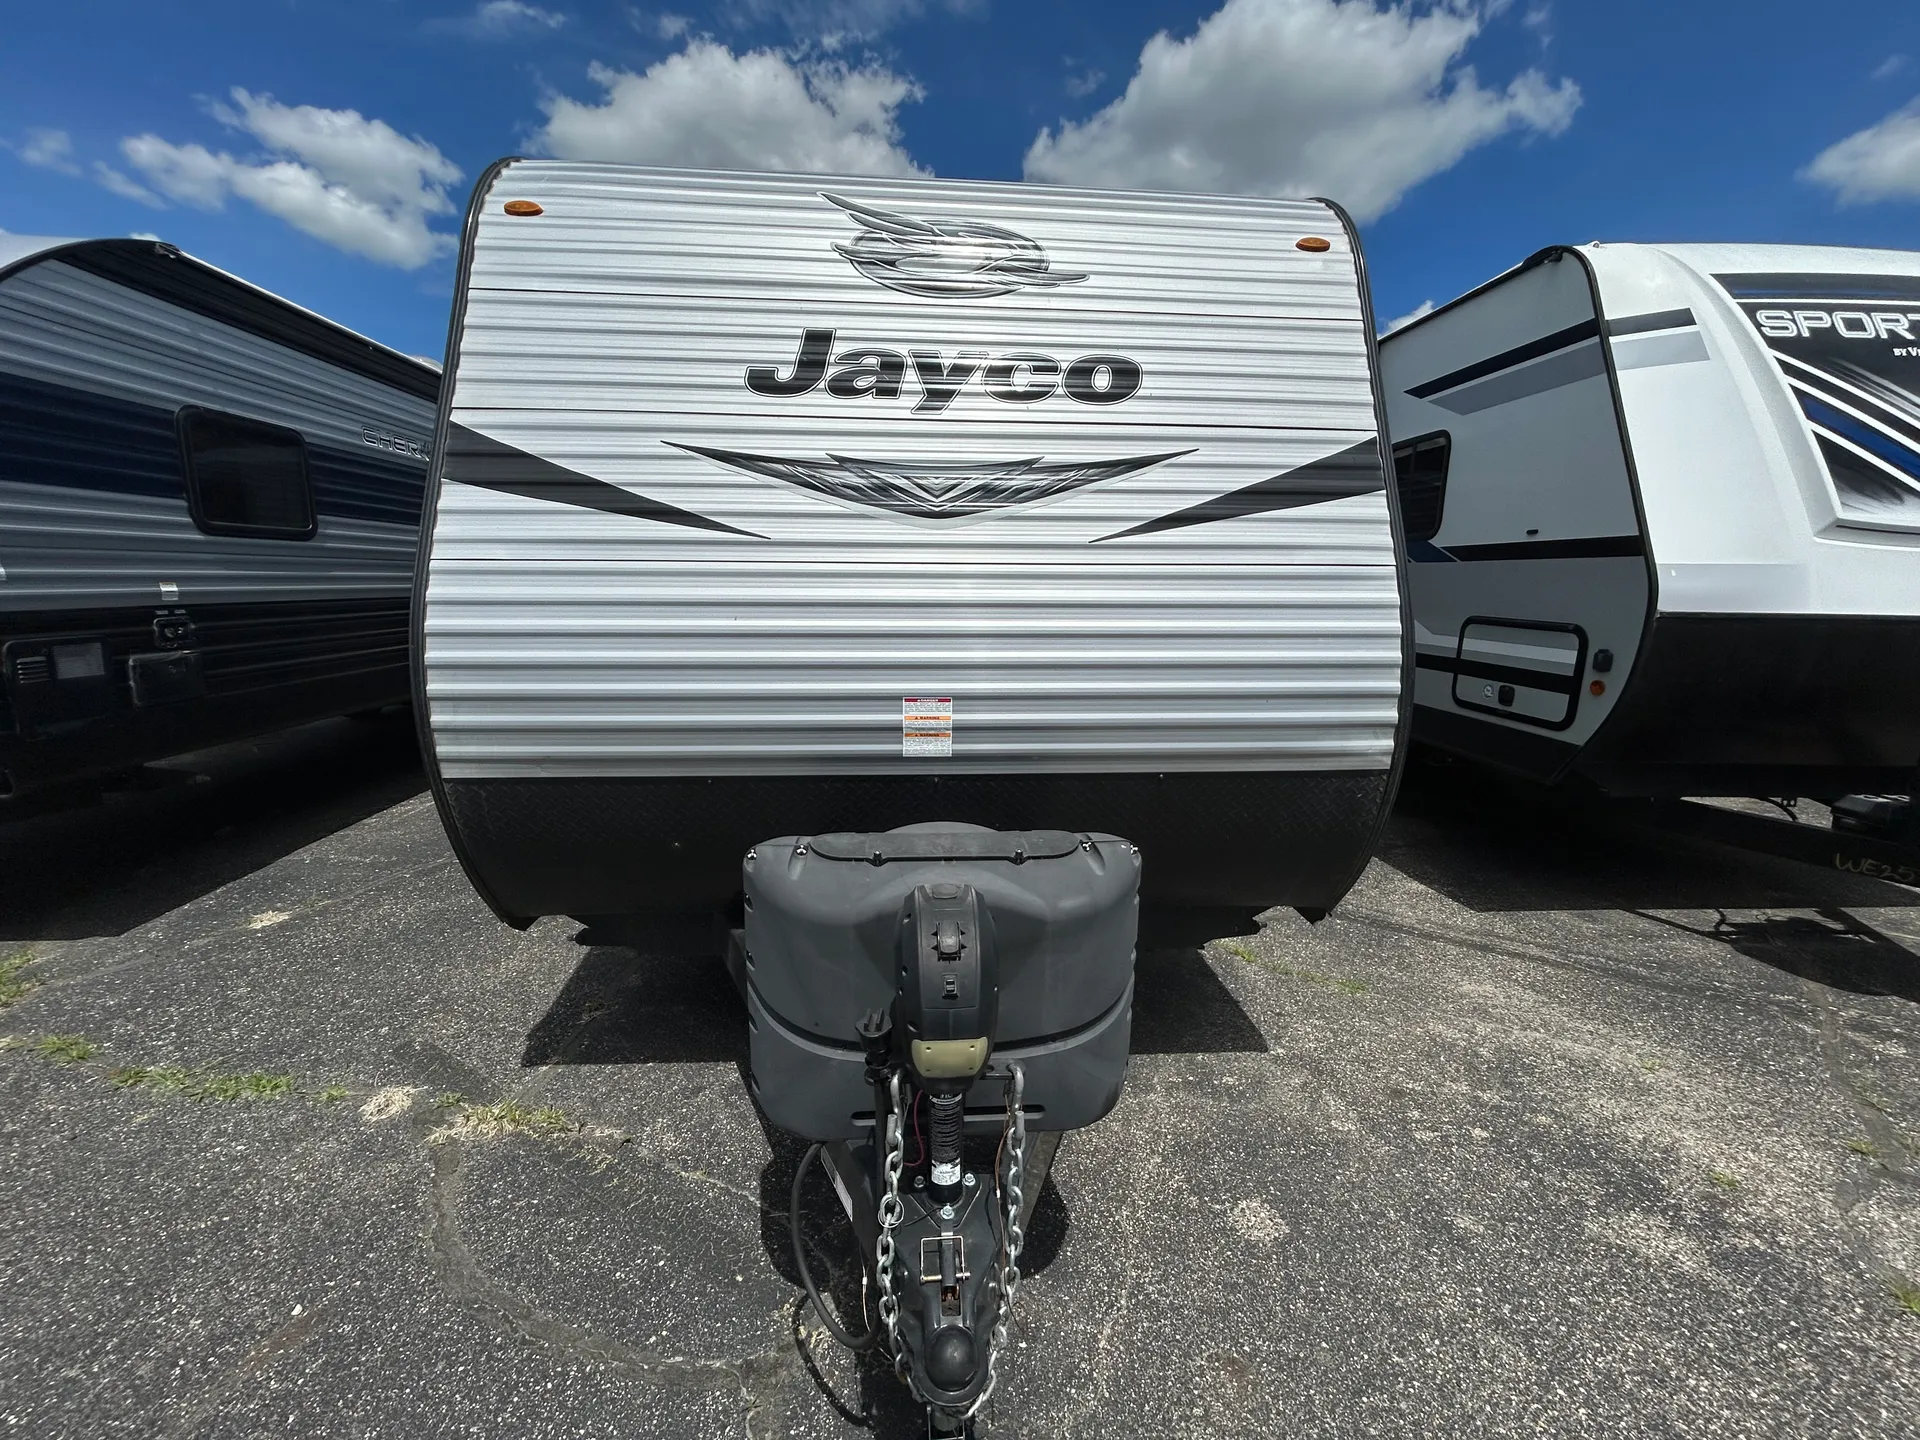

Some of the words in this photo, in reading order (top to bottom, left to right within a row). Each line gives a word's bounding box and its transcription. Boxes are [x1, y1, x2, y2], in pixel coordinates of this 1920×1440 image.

[744, 327, 1143, 415] Jayco
[1892, 348, 1907, 357] BY
[361, 425, 430, 462] CHER
